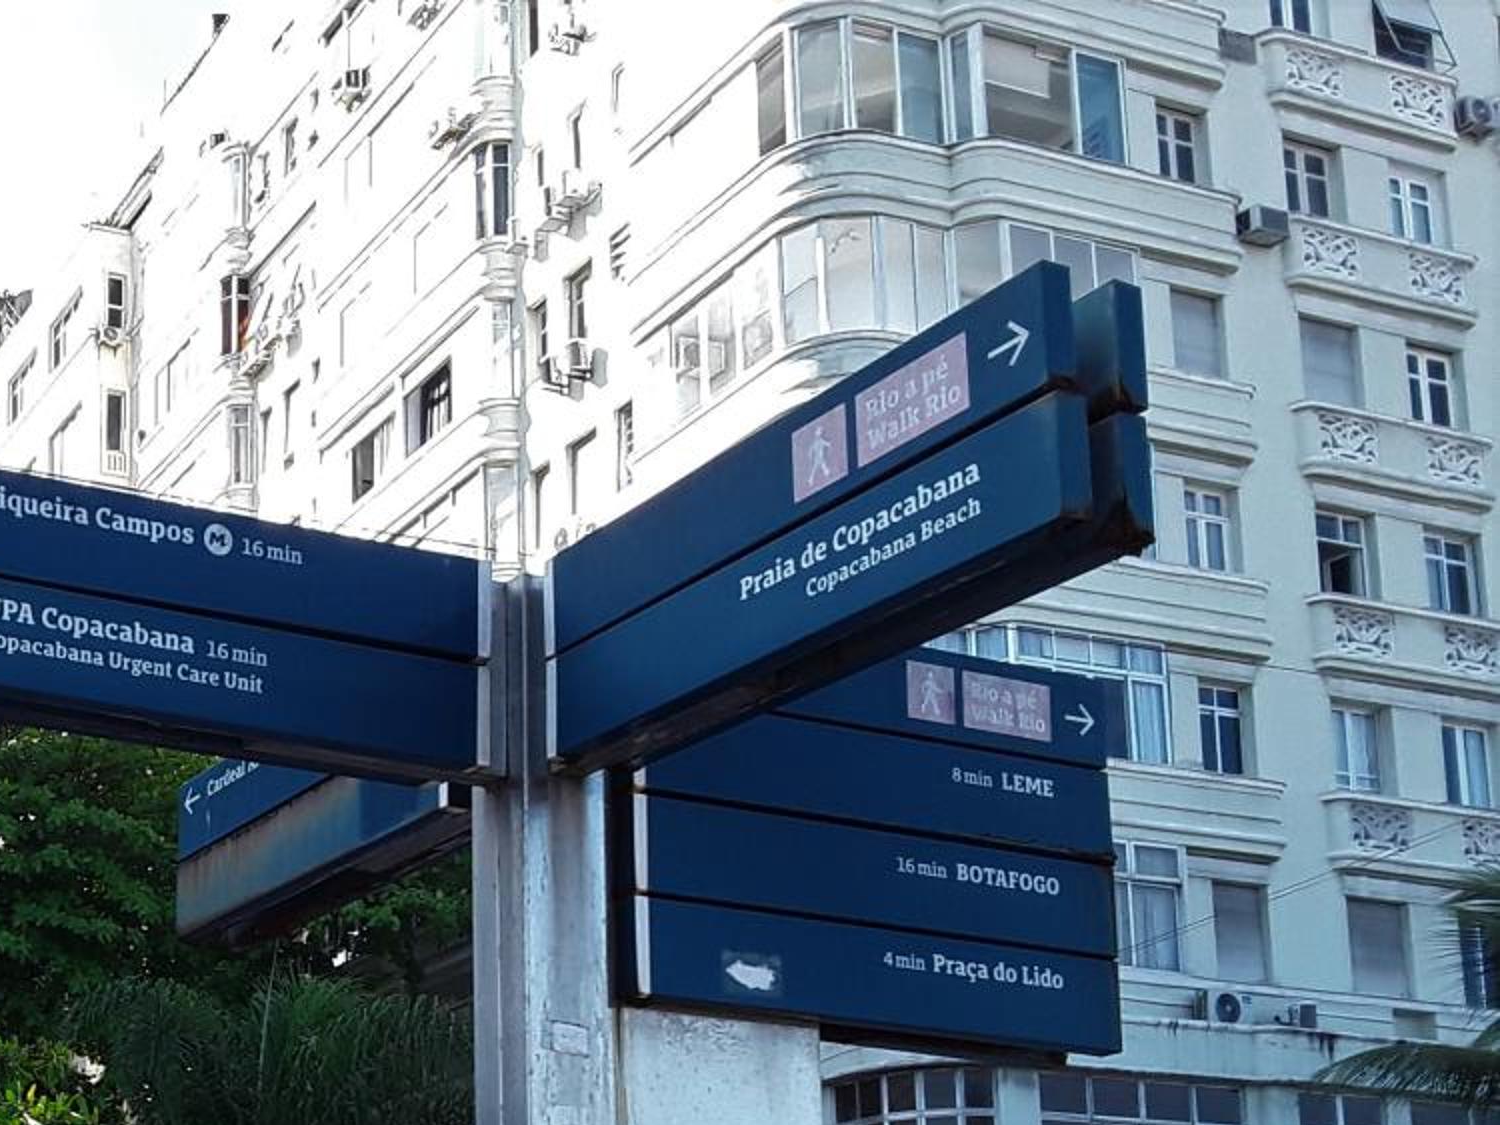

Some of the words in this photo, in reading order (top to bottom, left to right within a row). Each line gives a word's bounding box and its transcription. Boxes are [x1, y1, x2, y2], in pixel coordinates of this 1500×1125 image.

[866, 389, 899, 417] Rio
[904, 379, 917, 399] a
[922, 354, 948, 396] pé
[867, 406, 919, 449] Walk
[925, 385, 961, 417] Rio
[95, 506, 195, 544] Campos
[242, 538, 264, 557] 16
[267, 544, 303, 564] min
[739, 557, 796, 601] Praia
[801, 541, 827, 569] de
[833, 463, 981, 551] Copacabana
[806, 531, 916, 597] Copacabana
[920, 498, 981, 541] Beach
[41, 607, 195, 654] Copacabana
[206, 640, 229, 659] 16
[232, 647, 268, 667] min
[109, 651, 172, 679] Urgent
[177, 663, 220, 687] Care
[224, 671, 263, 694] Unit
[971, 681, 998, 702] Rio
[970, 704, 1015, 727] Walk
[1018, 712, 1046, 732] Rio
[951, 768, 961, 782] 8
[963, 768, 993, 788] min
[1001, 772, 1054, 798] LEME
[897, 856, 915, 874] 16
[917, 858, 948, 879] min
[956, 863, 1060, 896] BOTAFOGO
[883, 951, 893, 966] 4
[895, 953, 926, 972] min
[932, 954, 989, 984] Praça
[993, 959, 1017, 981] do
[1021, 964, 1064, 990] Lido
